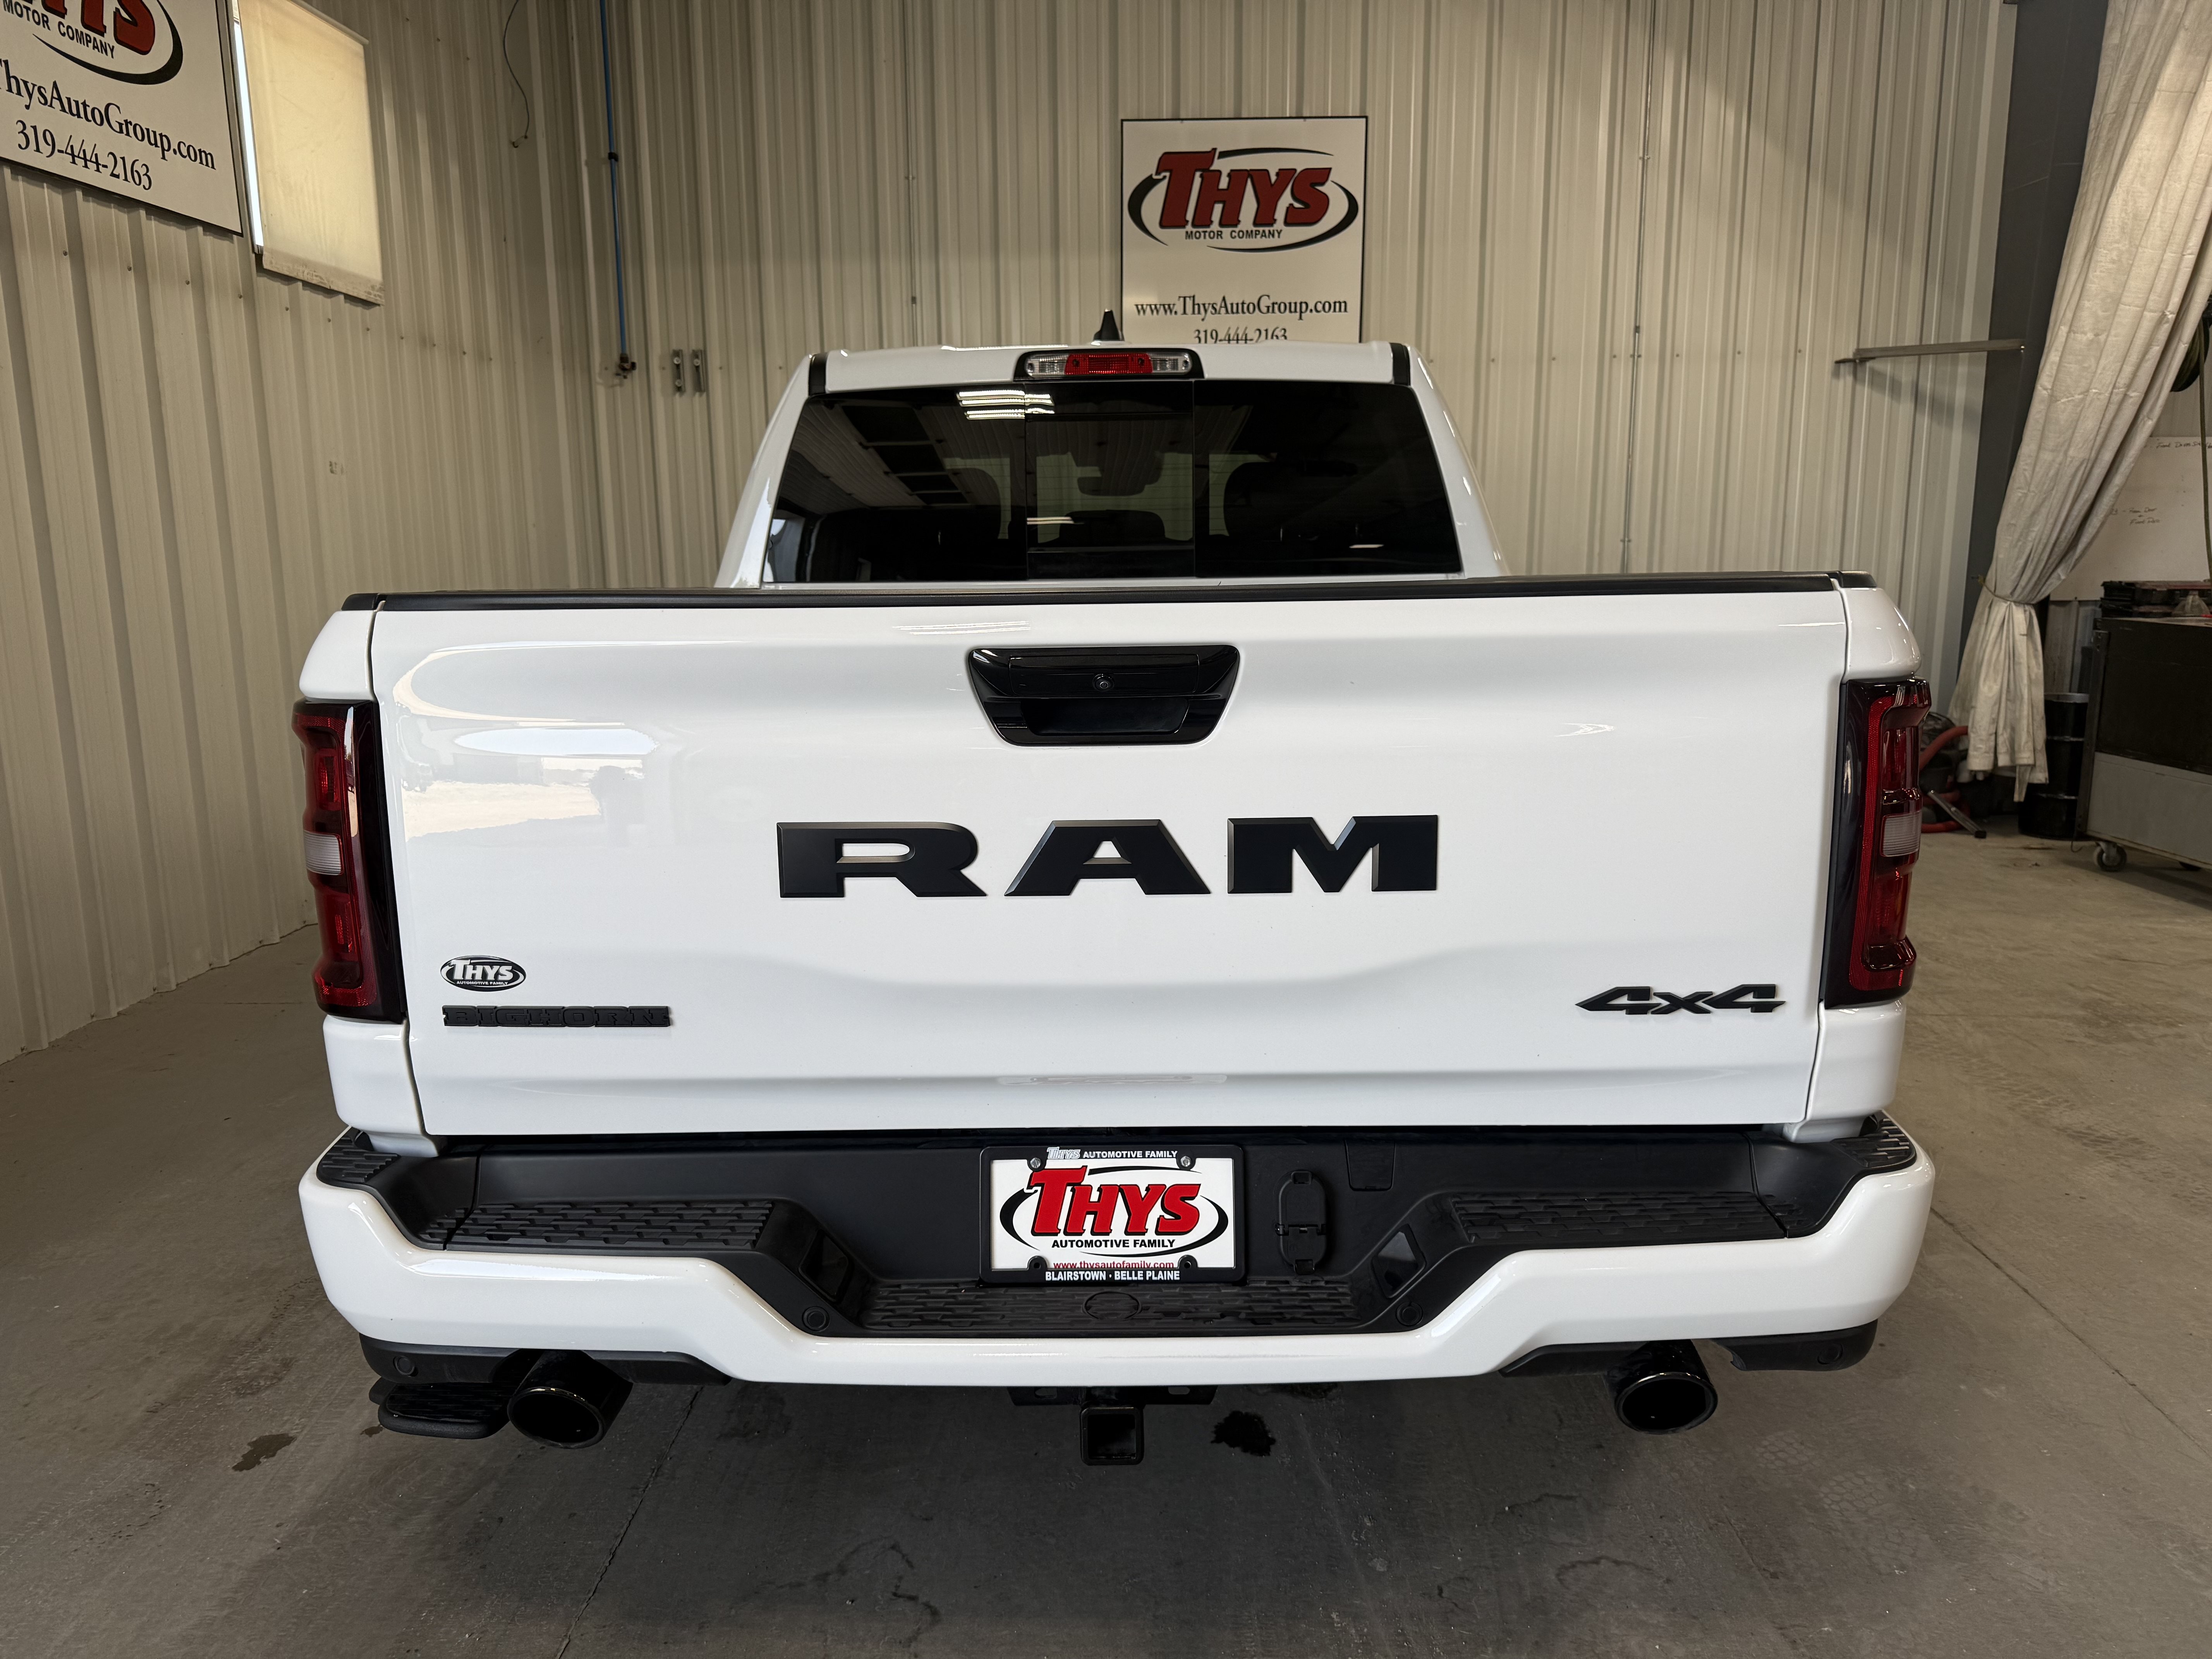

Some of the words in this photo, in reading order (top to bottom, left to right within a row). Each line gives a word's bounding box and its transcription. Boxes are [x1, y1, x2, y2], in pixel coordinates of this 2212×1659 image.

[3, 0, 51, 31] MOTOR
[58, 21, 115, 59] COMPANY
[0, 58, 216, 171] hysAutoGroup.com
[15, 119, 152, 191] 319-444-2163
[1155, 148, 1332, 229] THYS
[1185, 230, 1223, 240] MOTOR
[1230, 229, 1283, 239] COMPANY
[1134, 295, 1348, 321] www.ThysAutoGroup.com
[1194, 326, 1288, 344] 319-444-2163
[776, 815, 1438, 897] RAM
[448, 959, 514, 981] THYS
[1047, 1147, 1081, 1159] THYS
[1027, 1165, 1202, 1236] THYS
[1051, 1240, 1129, 1249] AUTOMOTIVE
[1133, 1239, 1176, 1248] FAMILY
[1046, 1271, 1106, 1281] BLAIRSTOWN
[1115, 1271, 1144, 1280] BELLE
[1146, 1271, 1180, 1280] PLAINE
[1053, 1261, 1174, 1269] www.thysautofamily.com
